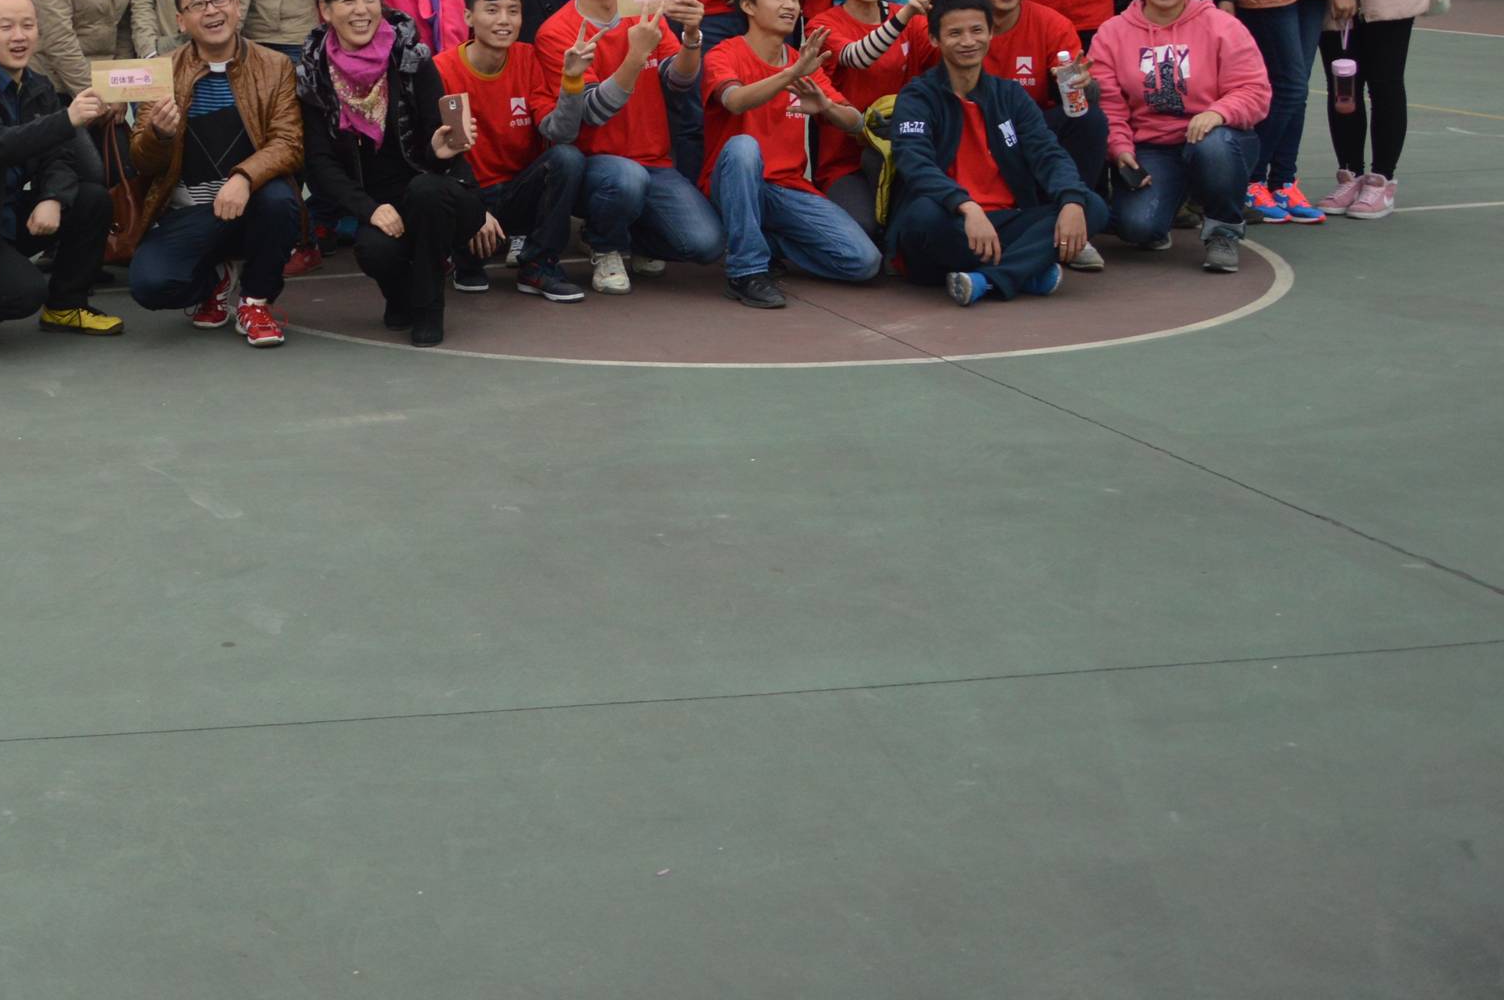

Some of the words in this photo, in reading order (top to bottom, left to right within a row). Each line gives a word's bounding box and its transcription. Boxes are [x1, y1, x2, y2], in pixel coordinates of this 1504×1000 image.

[111, 75, 151, 85] 团体第一名
